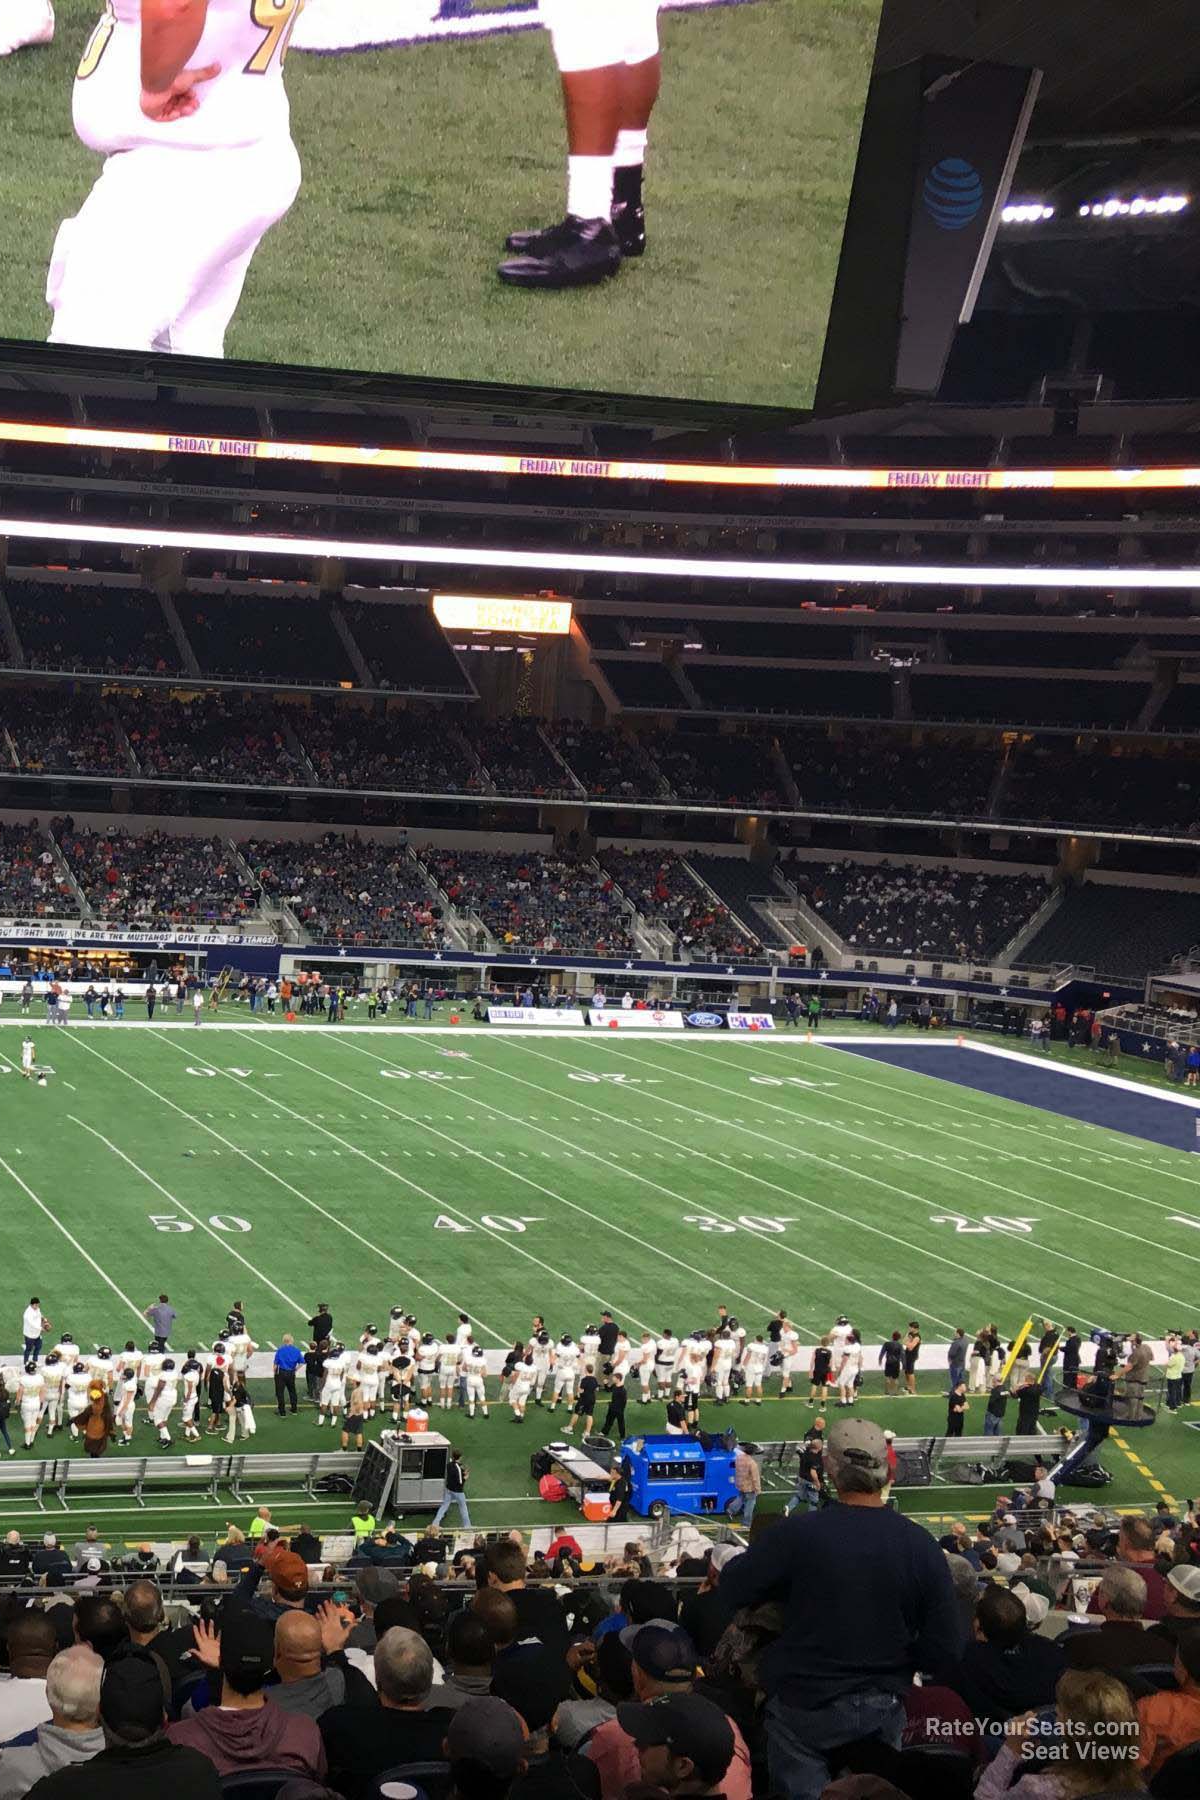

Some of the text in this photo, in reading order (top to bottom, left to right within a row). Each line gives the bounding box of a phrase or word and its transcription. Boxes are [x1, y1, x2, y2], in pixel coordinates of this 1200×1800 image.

[168, 437, 214, 453] FRIDAY
[219, 440, 259, 456] NIGHT
[519, 458, 565, 474] FRIDAY
[570, 461, 611, 476] NIGHT
[887, 472, 939, 486] FRIDAY
[945, 472, 993, 487] NIGHT
[16, 929, 43, 937] FIGHT!
[47, 929, 68, 937] WIN!
[90, 931, 105, 939] ARE
[177, 934, 201, 943] GIVE
[695, 1014, 717, 1024] Ford
[185, 1067, 255, 1078] 40
[148, 1215, 252, 1233] 50
[432, 1215, 526, 1233] 40
[683, 1215, 786, 1233] 30
[929, 1215, 1032, 1234] 20
